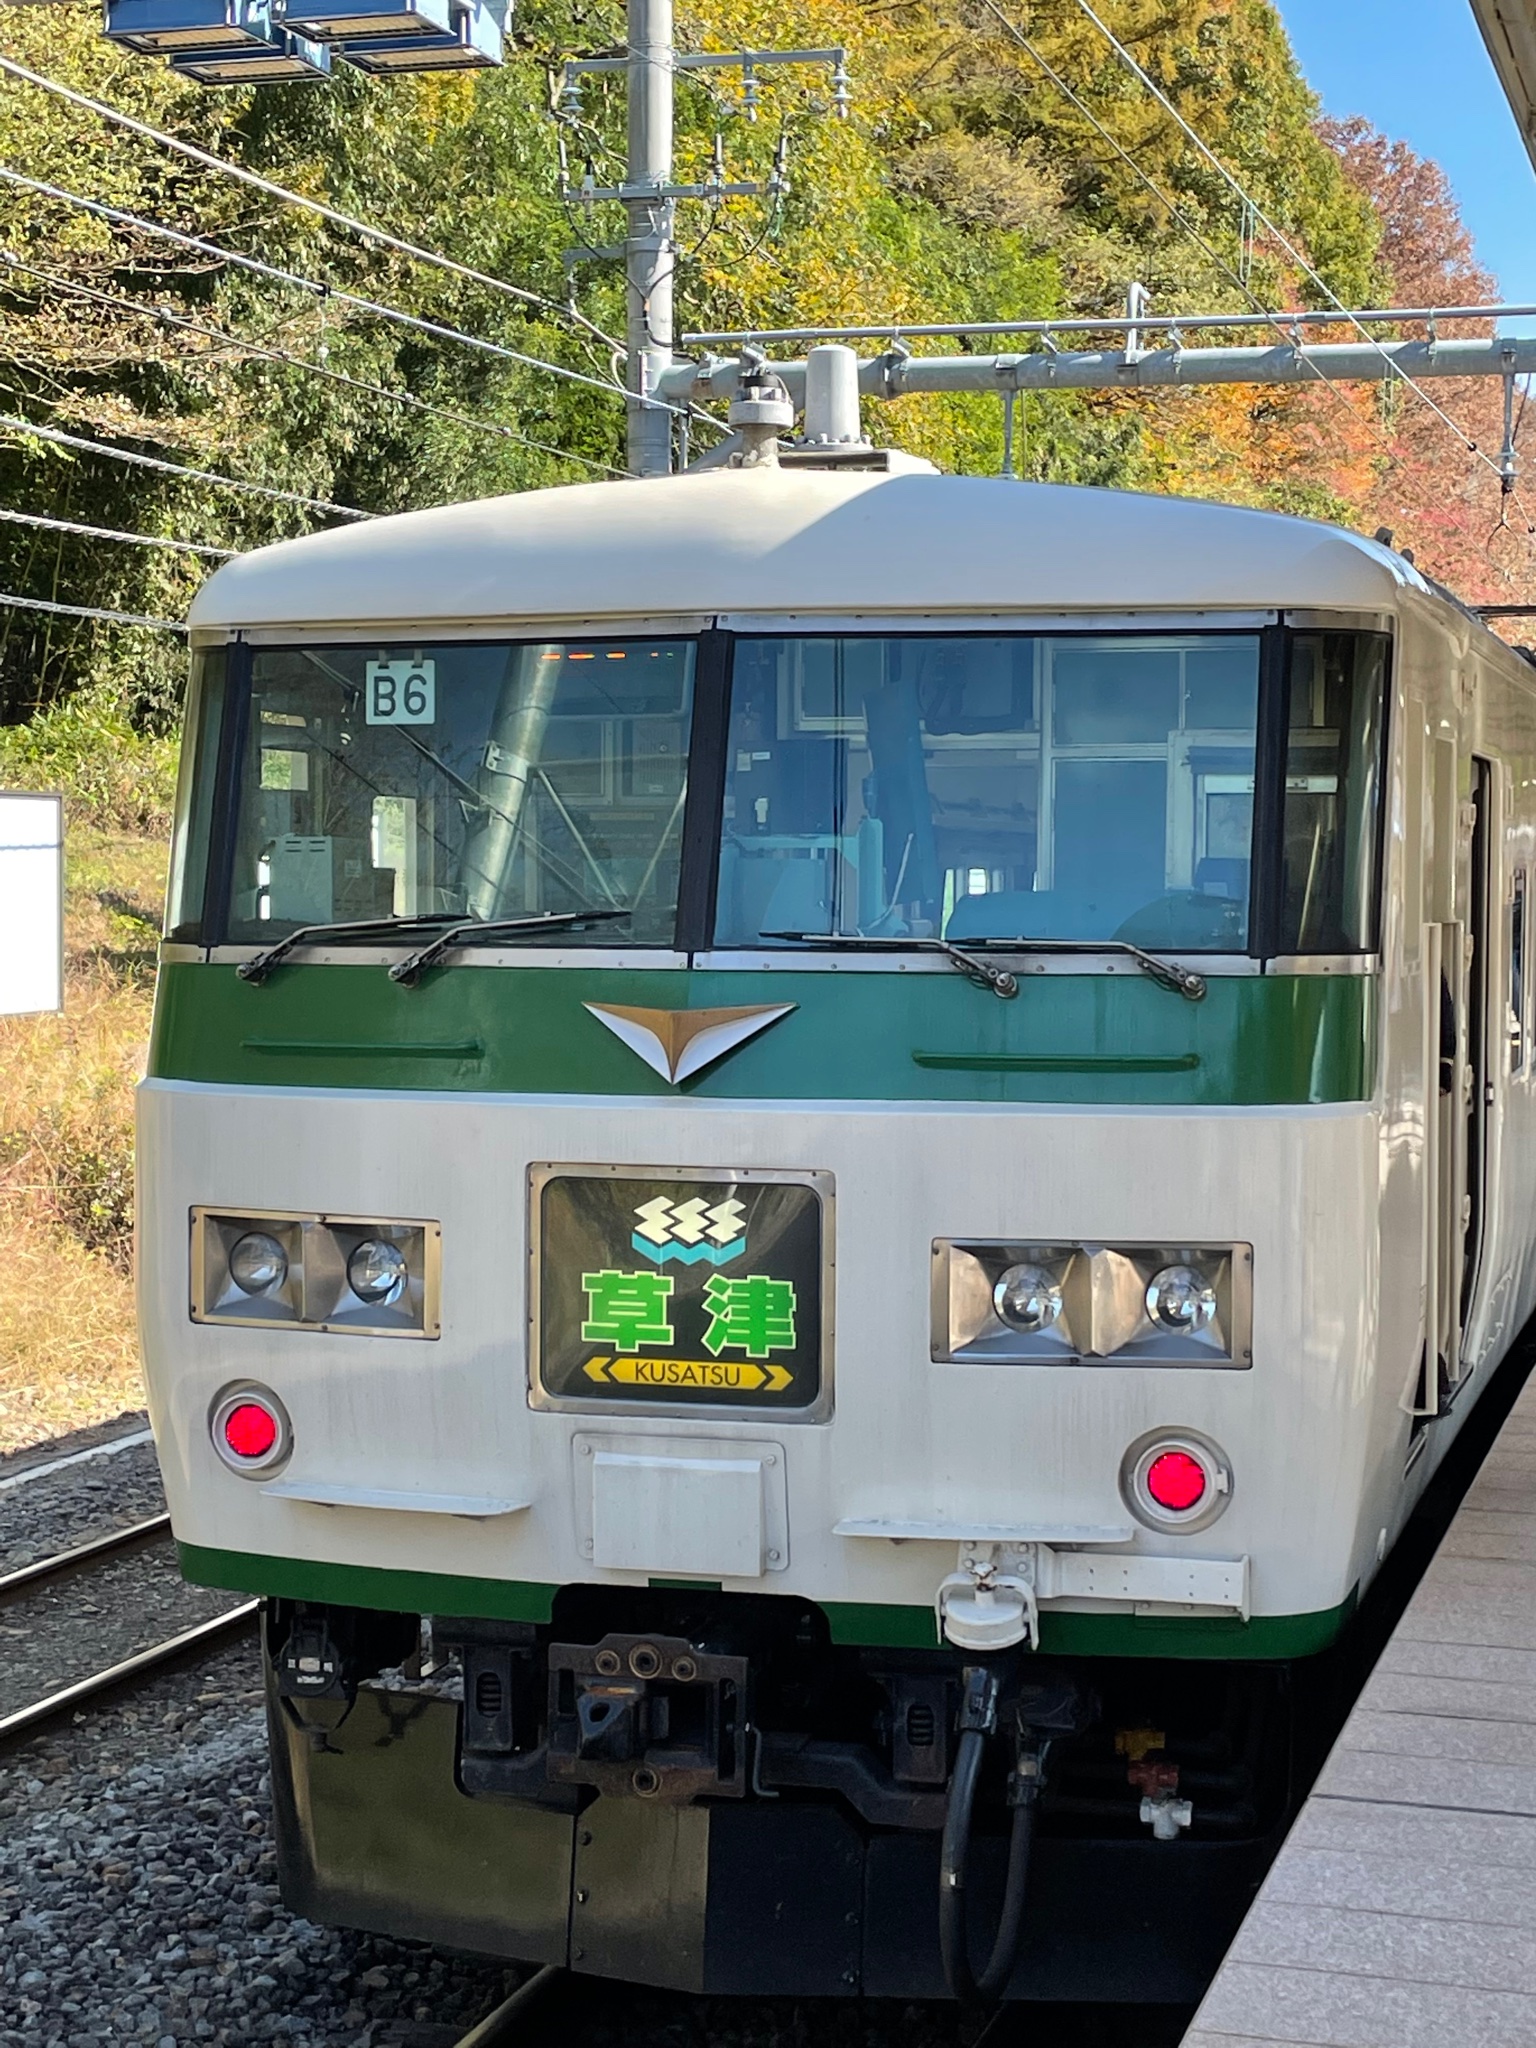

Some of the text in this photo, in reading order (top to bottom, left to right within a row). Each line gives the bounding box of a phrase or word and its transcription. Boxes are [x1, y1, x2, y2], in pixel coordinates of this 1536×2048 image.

[373, 674, 427, 716] B6
[581, 1269, 796, 1358] 草津
[635, 1362, 740, 1386] KUSATSU
